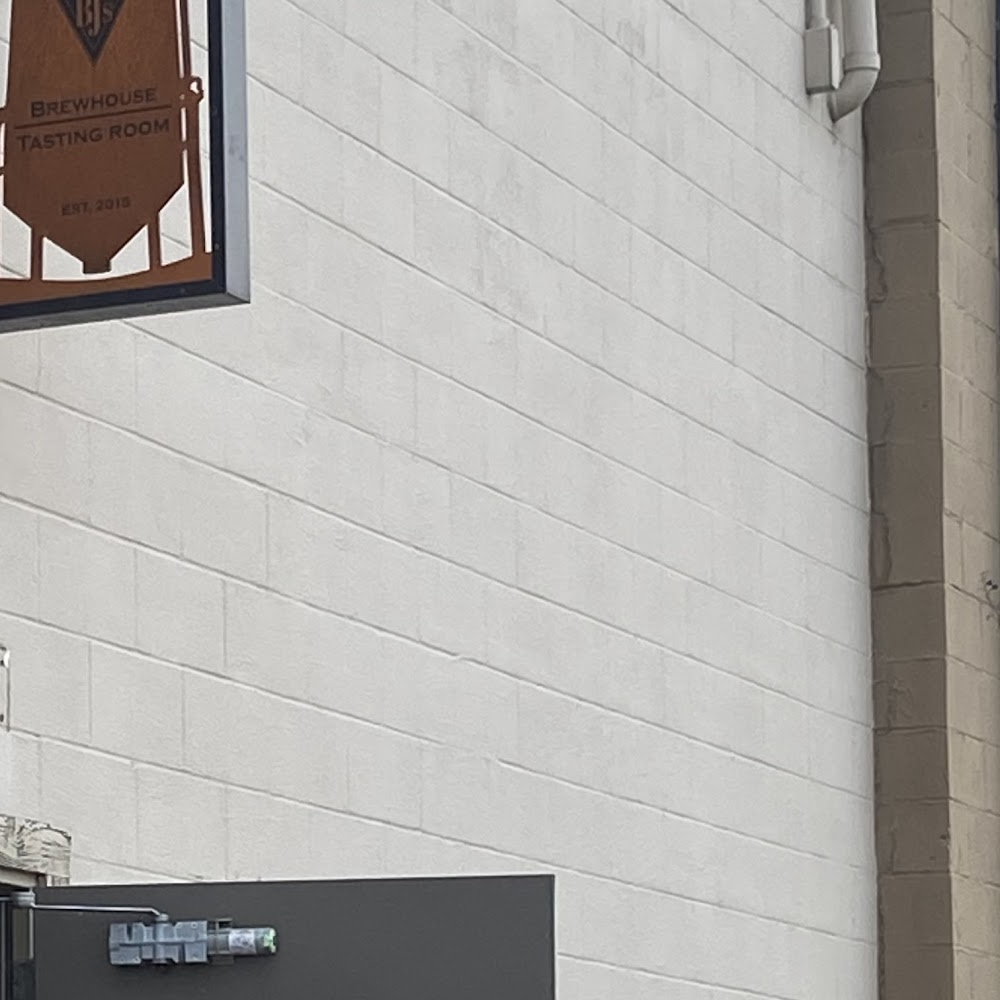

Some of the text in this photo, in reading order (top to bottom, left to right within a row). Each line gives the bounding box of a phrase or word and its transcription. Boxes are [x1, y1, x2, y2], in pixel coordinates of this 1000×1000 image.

[30, 88, 157, 118] BREWHOUSE
[16, 119, 169, 151] TASTING ROOM
